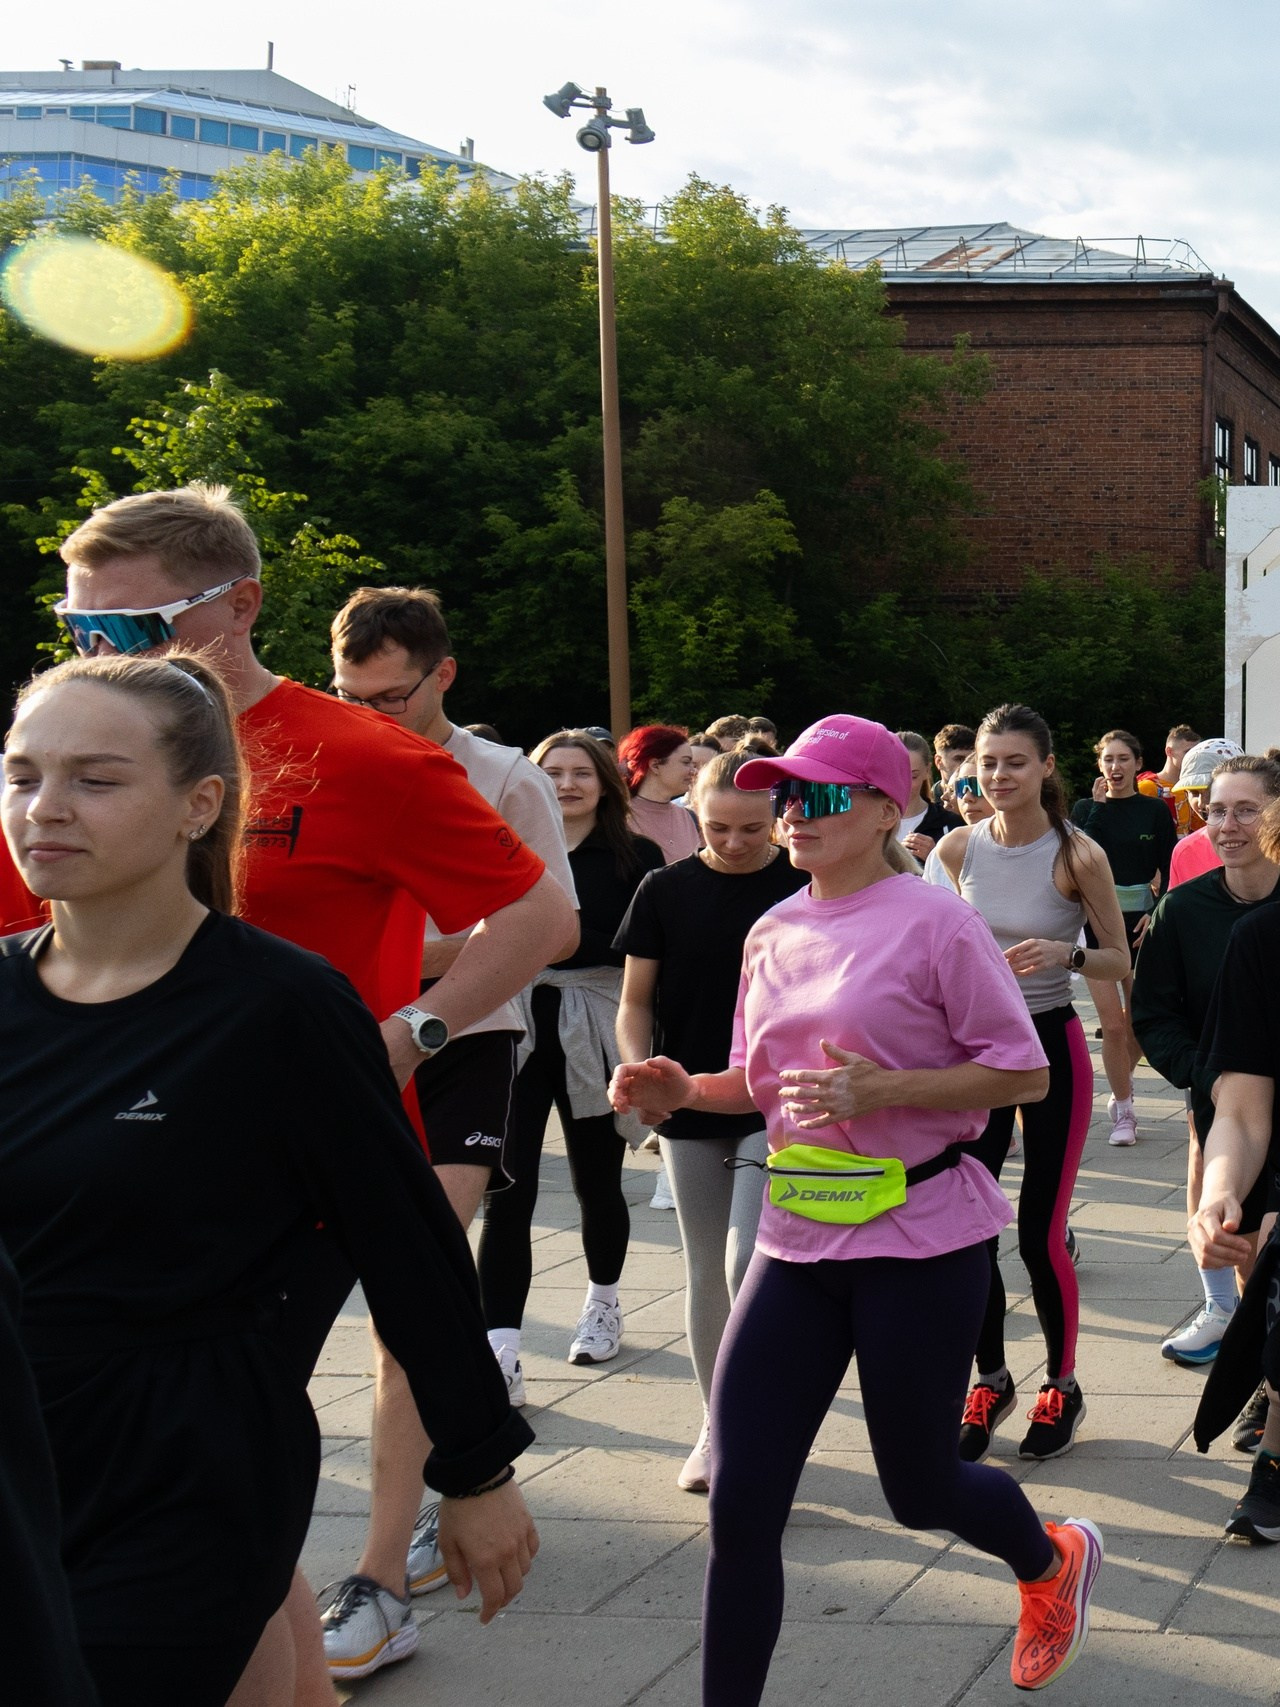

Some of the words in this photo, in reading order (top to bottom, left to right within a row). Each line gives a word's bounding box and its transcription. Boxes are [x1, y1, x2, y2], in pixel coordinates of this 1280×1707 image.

[839, 731, 851, 741] of
[114, 1112, 168, 1121] DEMIX
[480, 1135, 502, 1148] asics
[799, 1189, 868, 1202] DEMIX
